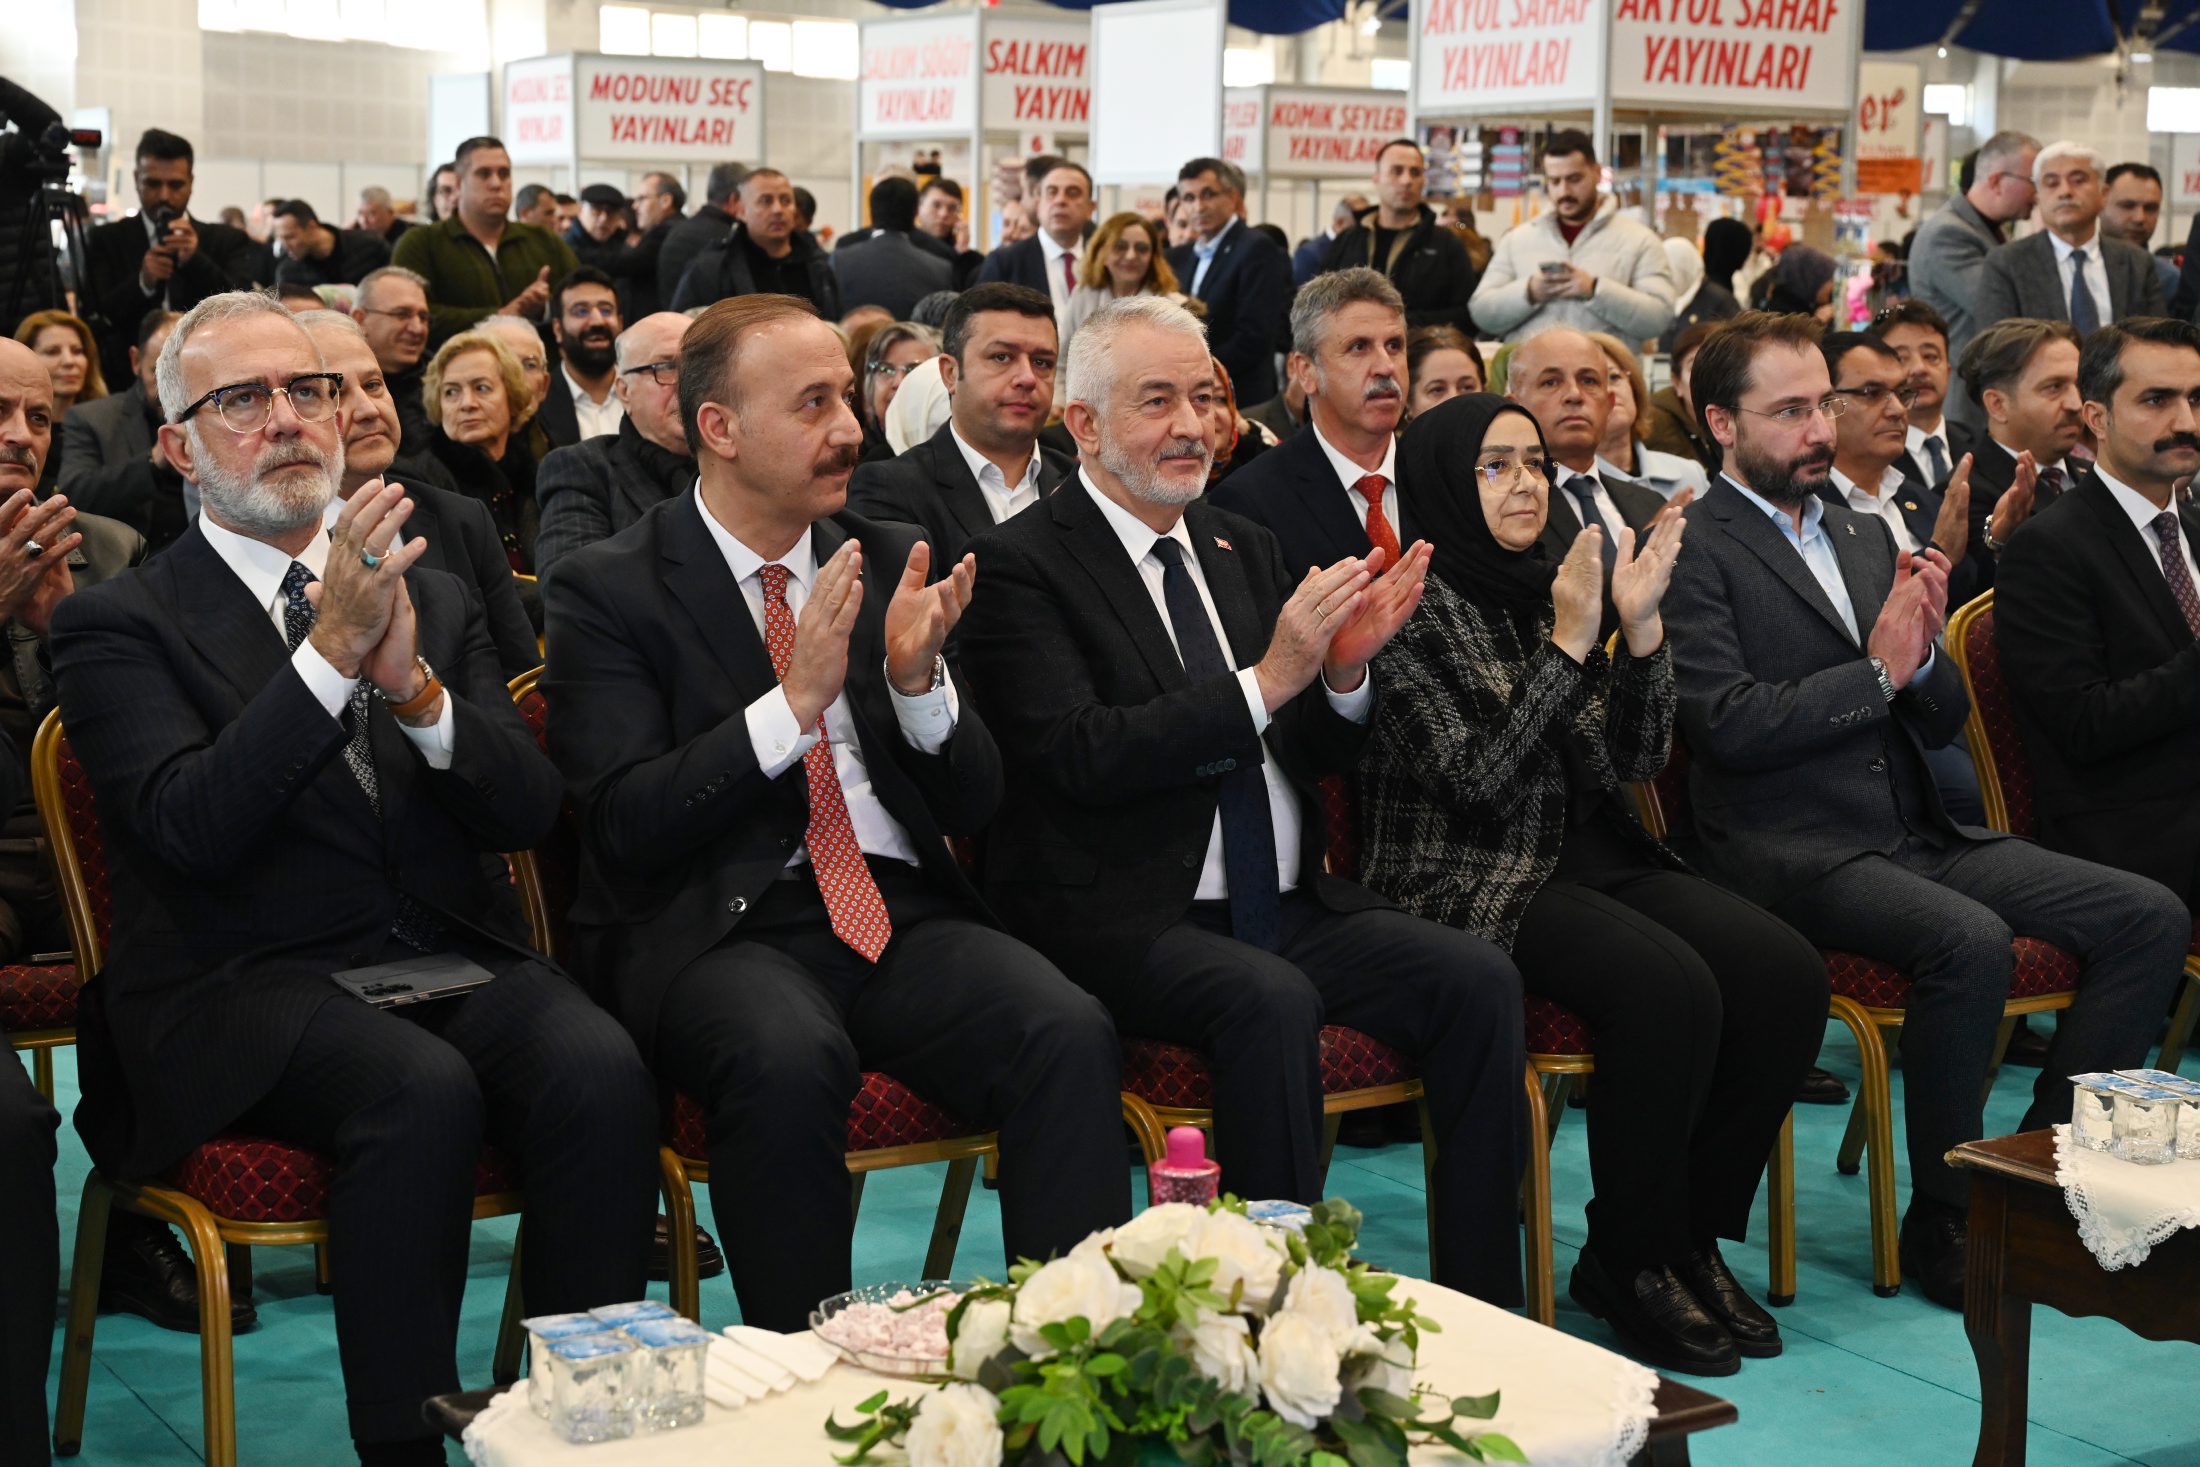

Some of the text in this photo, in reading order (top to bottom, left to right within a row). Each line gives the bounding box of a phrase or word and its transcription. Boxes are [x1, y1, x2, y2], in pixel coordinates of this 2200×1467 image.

[985, 39, 1086, 77] SALKIM
[1443, 38, 1570, 91] YAYINLARI
[1644, 36, 1812, 91] YAYINLARI
[590, 74, 701, 104] MODUNU
[708, 78, 752, 112] SEÇ
[610, 115, 734, 145] YAYINLARI
[1289, 136, 1382, 162] YAYINLAR
